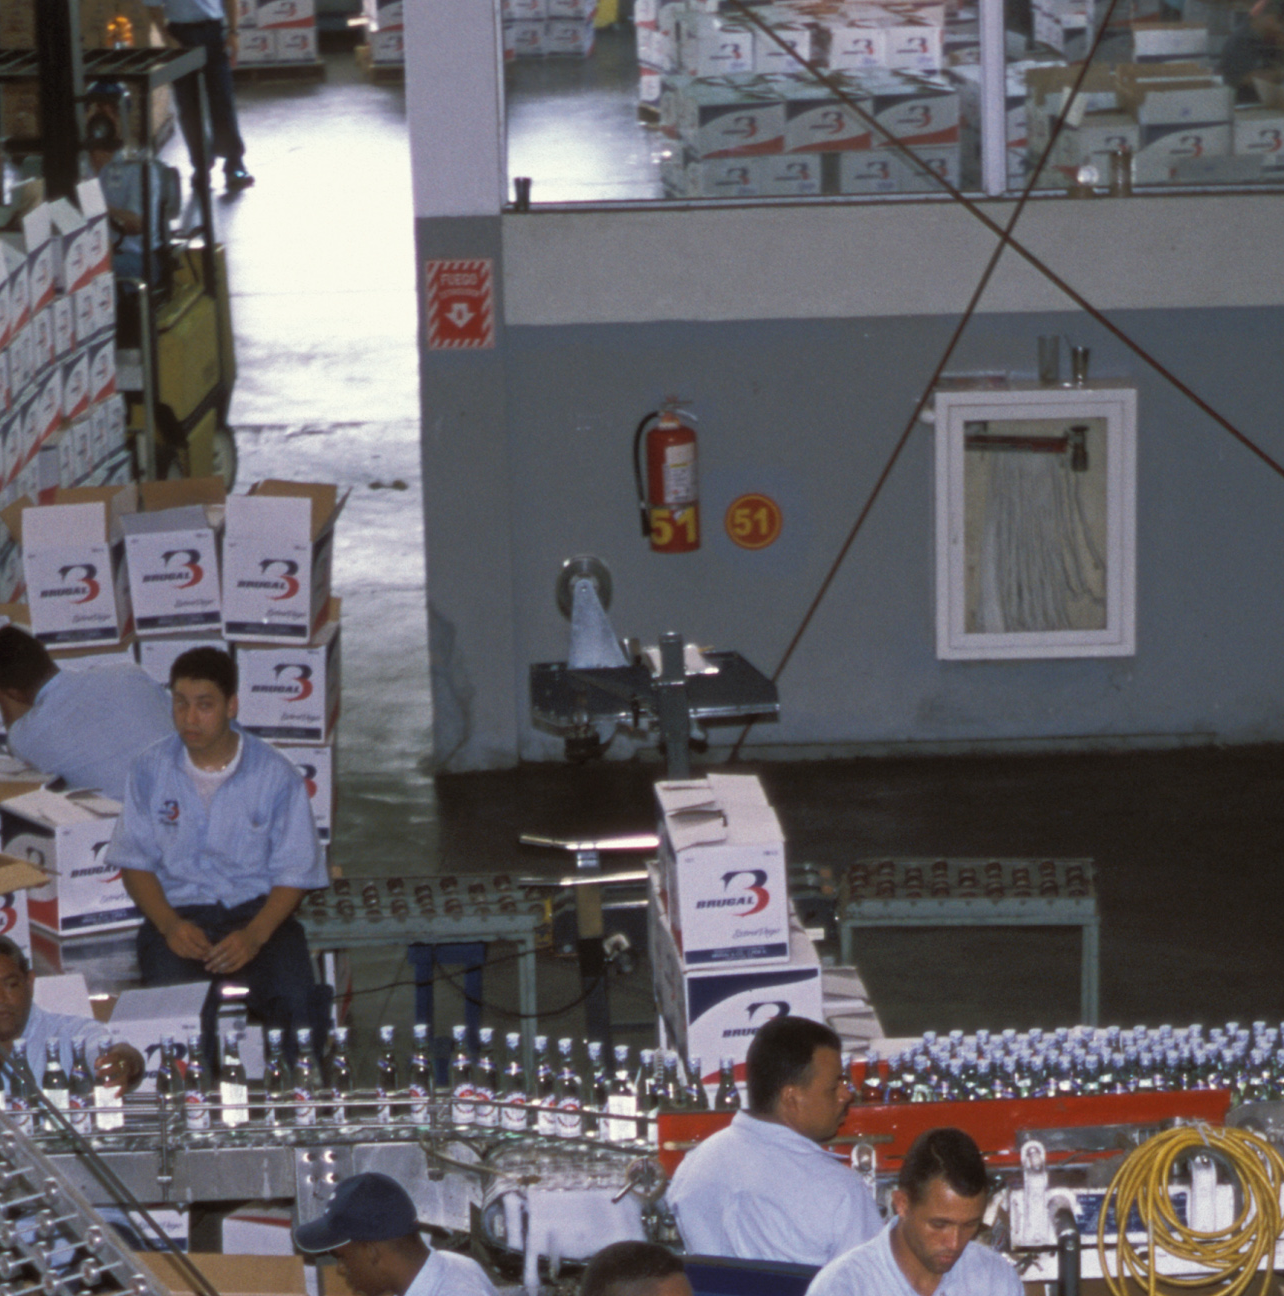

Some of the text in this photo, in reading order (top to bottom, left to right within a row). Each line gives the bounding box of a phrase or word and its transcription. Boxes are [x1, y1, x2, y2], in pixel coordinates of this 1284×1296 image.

[440, 274, 479, 286] FUEGO
[650, 507, 698, 545] 51
[732, 509, 770, 537] 51
[696, 897, 755, 909] BRUGAL
